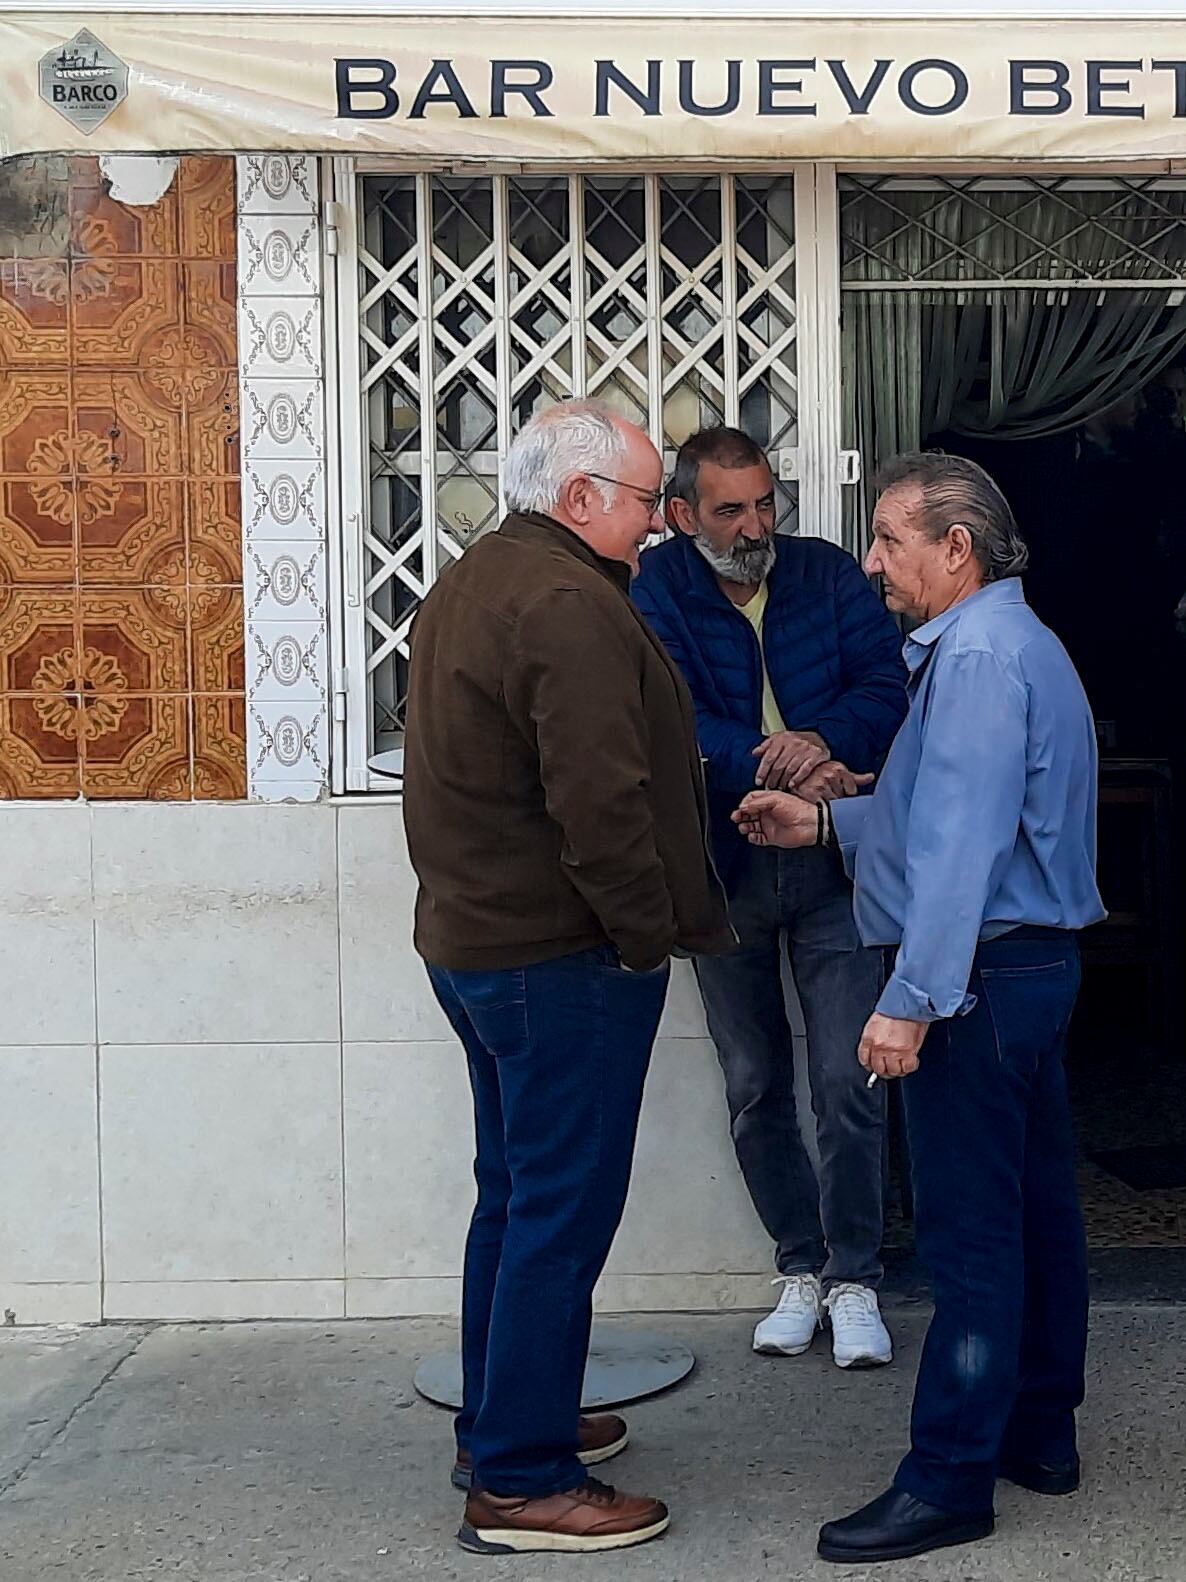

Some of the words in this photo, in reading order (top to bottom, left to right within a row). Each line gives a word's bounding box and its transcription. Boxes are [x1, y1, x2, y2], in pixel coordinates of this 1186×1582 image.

[52, 84, 117, 102] BARCO
[333, 57, 556, 119] BAR
[592, 57, 970, 117] NUEVO
